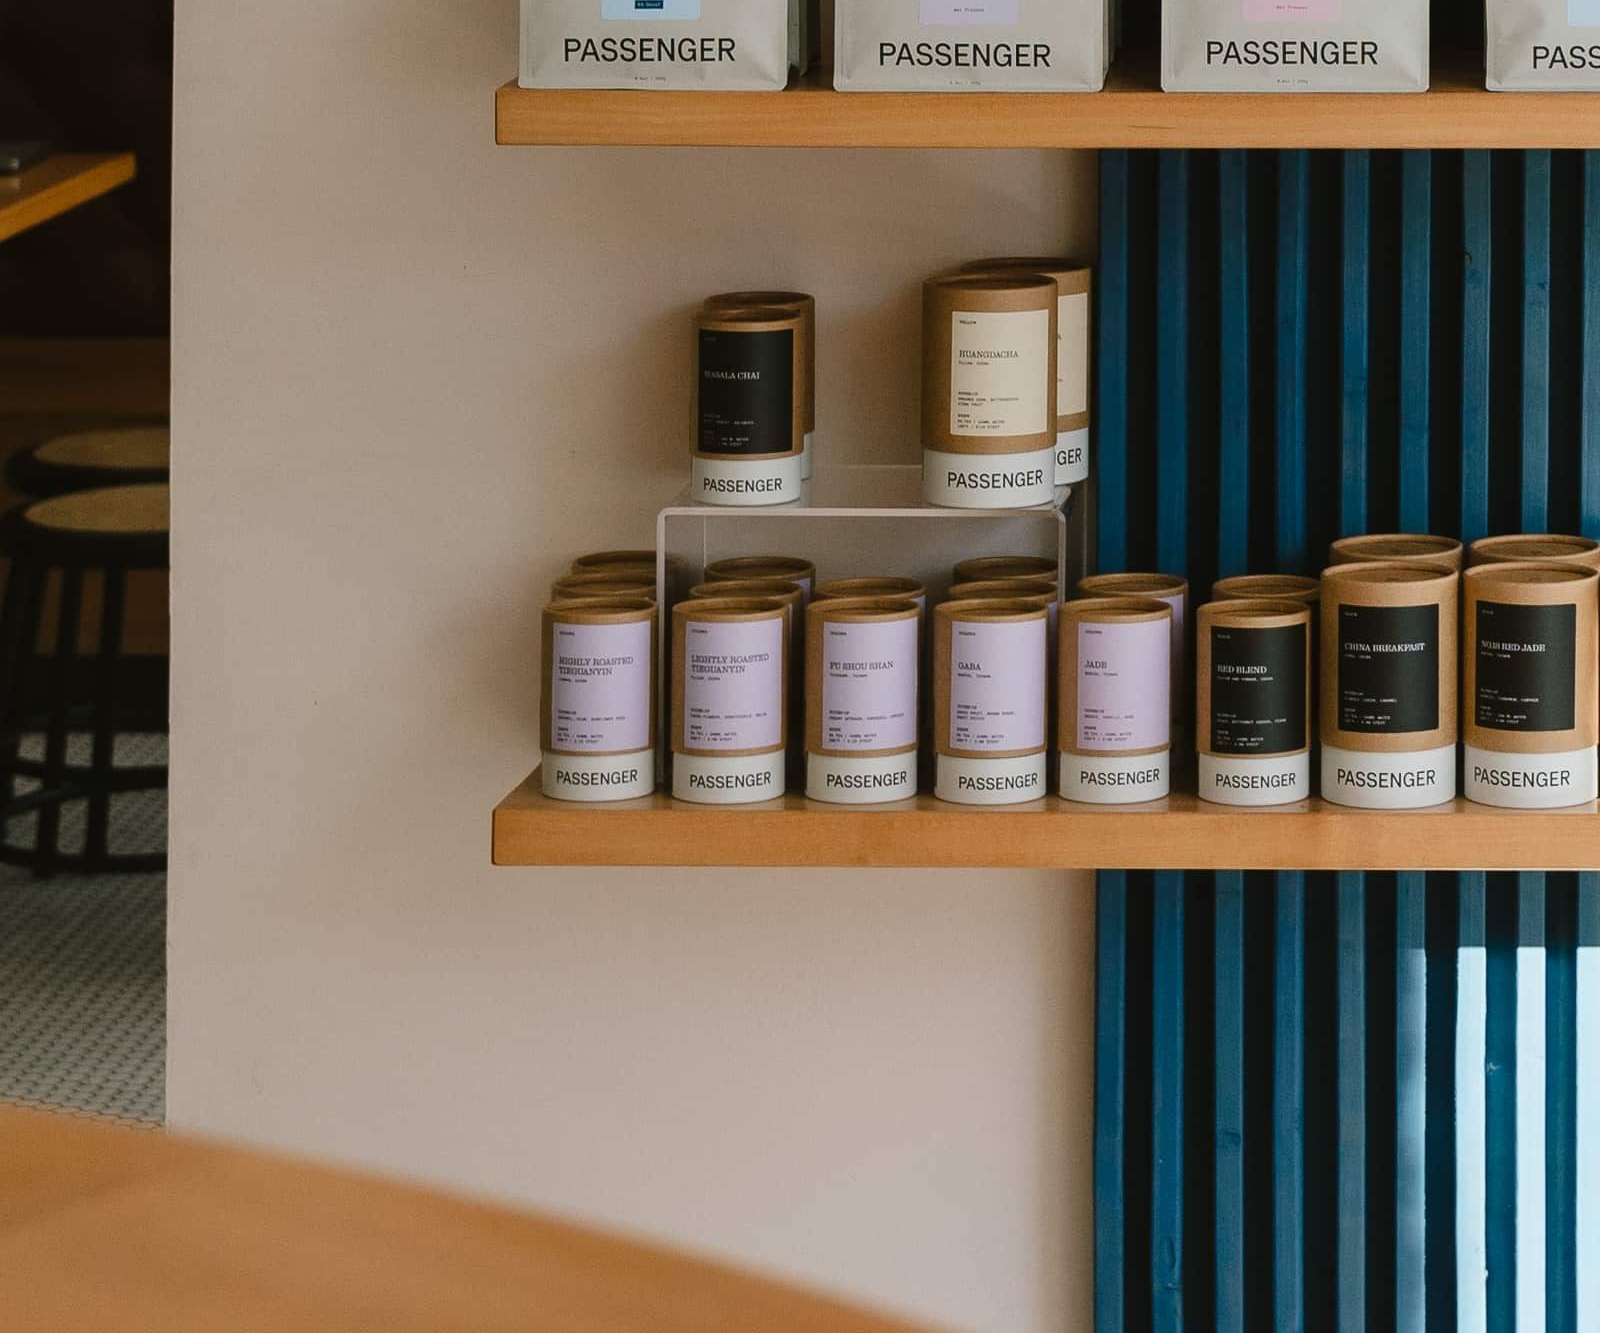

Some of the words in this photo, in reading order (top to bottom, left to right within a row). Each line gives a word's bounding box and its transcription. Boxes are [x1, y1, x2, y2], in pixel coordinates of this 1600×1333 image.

[565, 38, 735, 62] PASSENGER
[880, 43, 1050, 67] PASSENGER
[1207, 41, 1377, 64] PASSENGER
[959, 349, 1020, 359] HUANGDACHA
[704, 478, 782, 492] PASSENGER
[948, 470, 1042, 489] PASSENGER
[1344, 642, 1371, 652] CHINA
[1372, 642, 1425, 652] BREAKFAST
[1502, 642, 1521, 652] RED
[1521, 643, 1546, 653] JADE
[559, 657, 591, 666] HIGHLY
[593, 656, 634, 666] ROASTED
[691, 654, 728, 664] LIGHTLY
[730, 653, 770, 664] ROASTED
[843, 662, 868, 670] SHOU
[958, 661, 982, 671] GABA
[1084, 660, 1107, 669] JADE
[1217, 664, 1234, 673] RED
[1236, 665, 1267, 674] BLEND
[557, 770, 637, 785] PASSENGER
[690, 772, 770, 788] PASSENGER
[827, 772, 906, 788] PASSENGER
[959, 773, 1037, 790] PASSENGER
[1081, 769, 1159, 785] PASSENGER
[1216, 773, 1295, 788] PASSENGER
[1338, 769, 1435, 788] PASSENGER
[1475, 767, 1569, 787] PASSENGER
